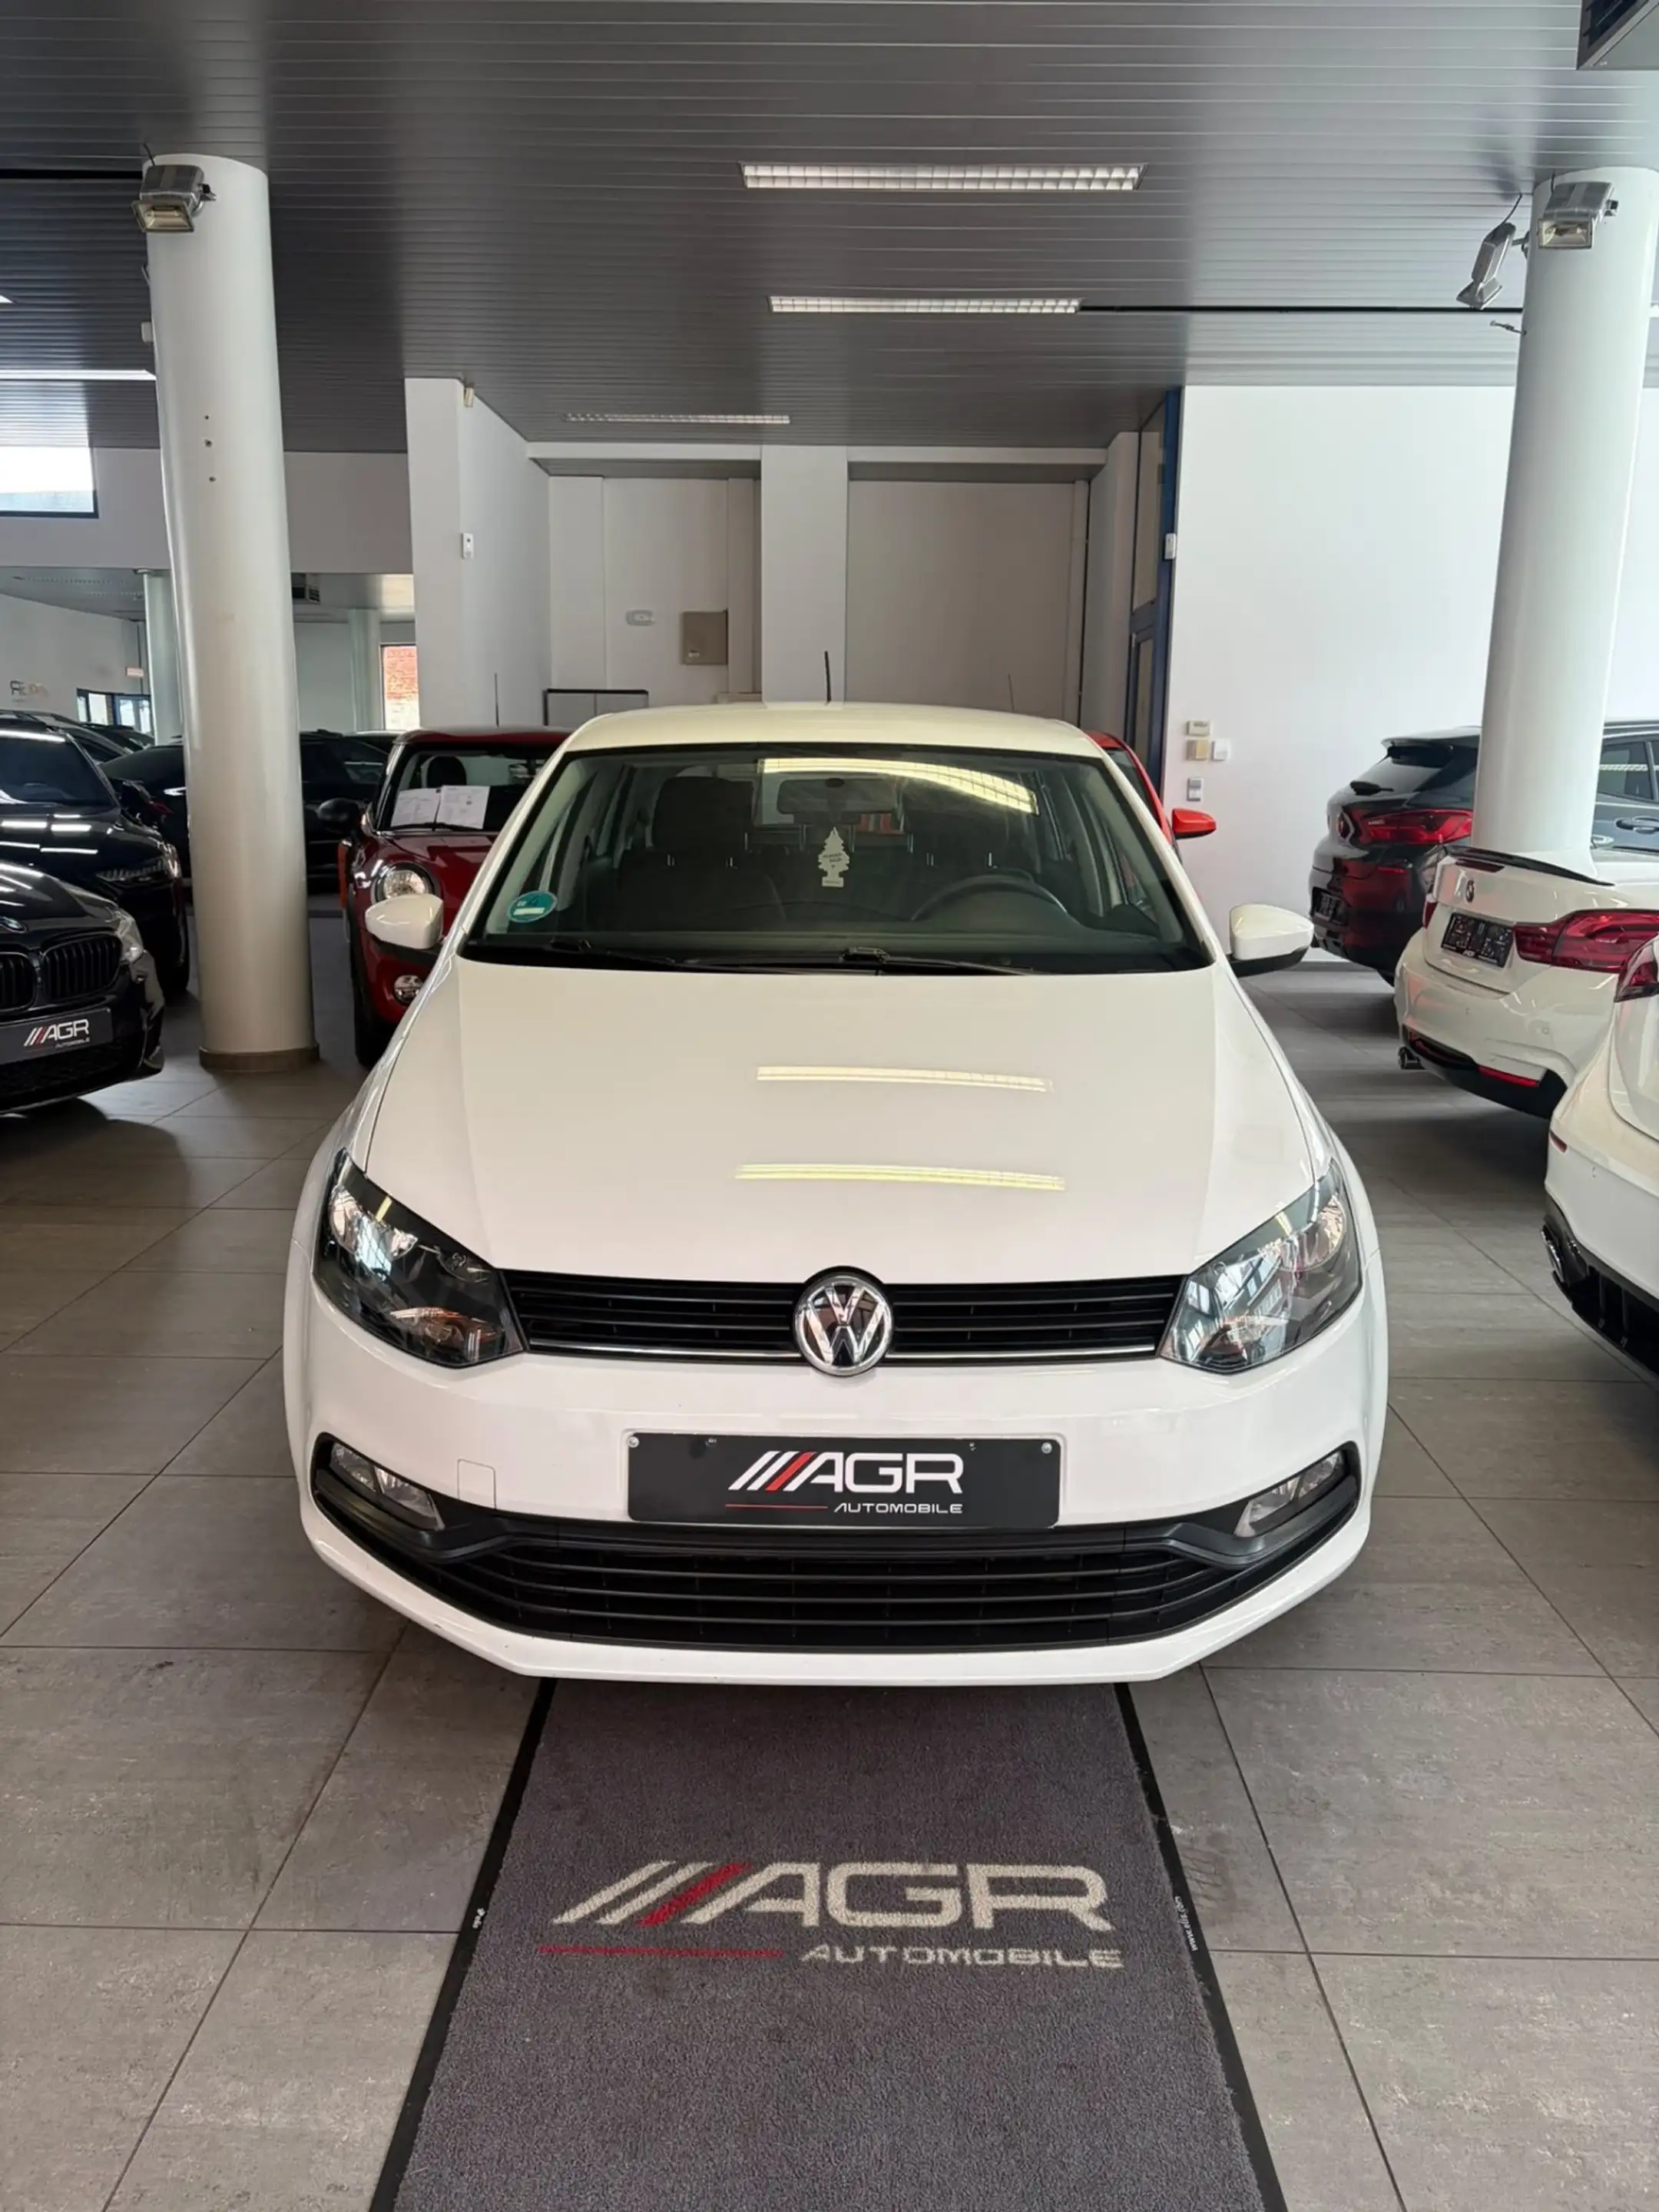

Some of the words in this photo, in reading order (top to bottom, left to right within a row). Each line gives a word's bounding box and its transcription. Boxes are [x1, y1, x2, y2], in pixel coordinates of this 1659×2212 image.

[40, 1018, 89, 1044] AGR
[782, 1452, 964, 1494] AGR
[833, 1502, 963, 1514] AUTOMOBILE
[680, 1862, 1112, 1931] AGR
[799, 1944, 1124, 1969] AUTOMOBILE
